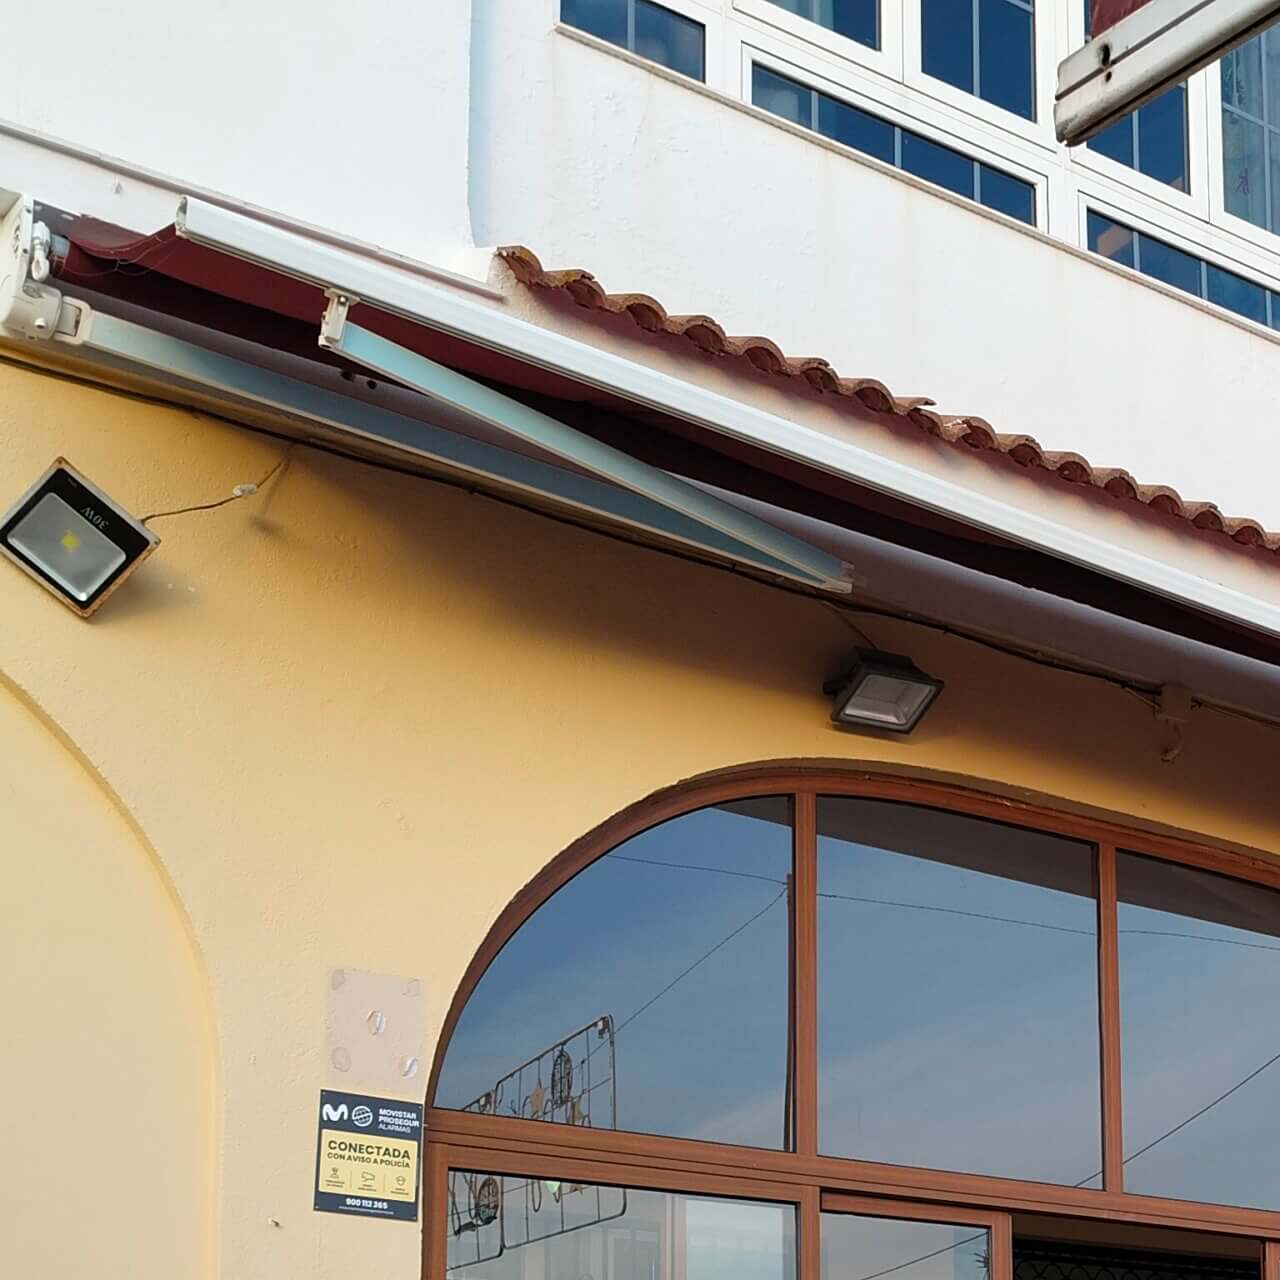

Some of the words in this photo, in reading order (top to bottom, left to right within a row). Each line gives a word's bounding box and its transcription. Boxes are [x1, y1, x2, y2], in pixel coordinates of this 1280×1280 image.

[379, 1108, 417, 1120] MOVISTAR
[378, 1115, 420, 1128] PROSEGUR
[378, 1123, 412, 1134] ALARMAS
[327, 1140, 411, 1161] CONECTADA
[327, 1152, 346, 1161] CON
[346, 1153, 372, 1164] AVISO
[373, 1157, 380, 1165] A
[379, 1158, 411, 1169] POLICÍA
